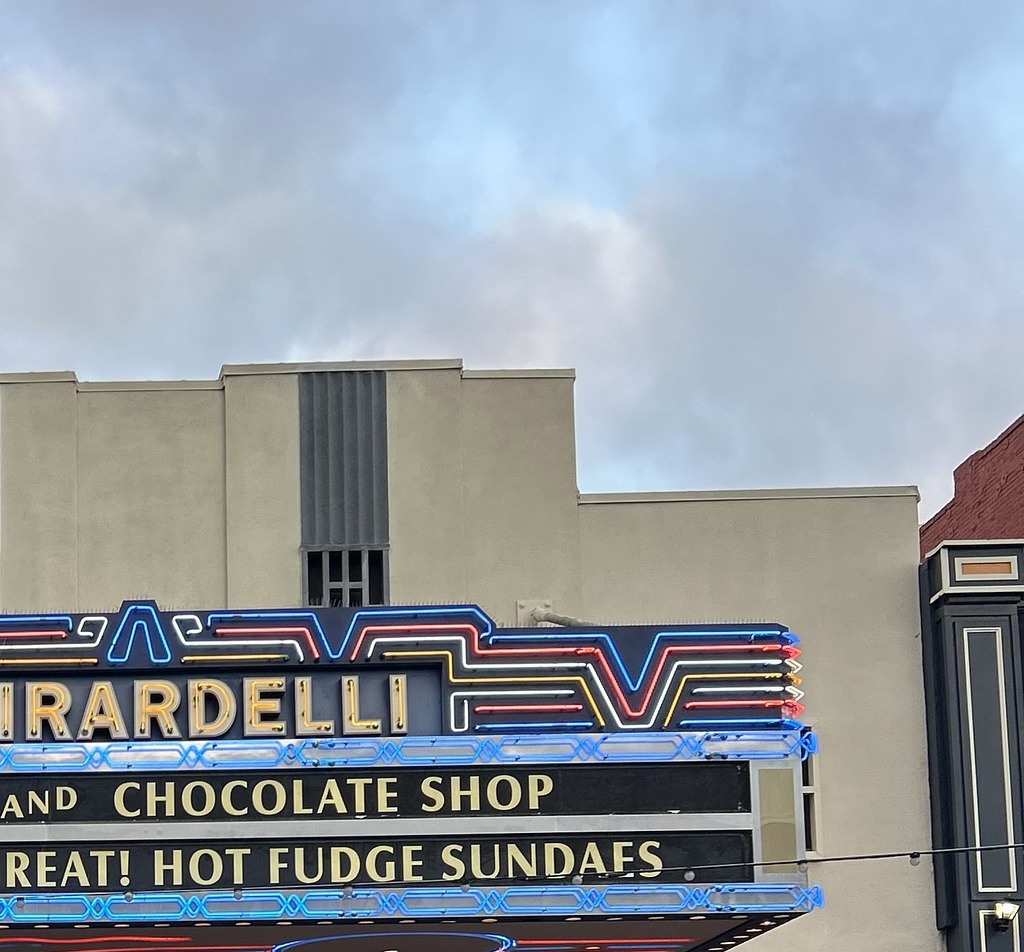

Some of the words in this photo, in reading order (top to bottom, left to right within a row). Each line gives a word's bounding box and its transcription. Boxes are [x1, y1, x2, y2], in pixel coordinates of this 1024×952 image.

[0, 787, 78, 820] AND
[113, 777, 399, 818] CHOCOLATE
[420, 774, 555, 812] SHOP
[154, 848, 251, 886] HOT
[269, 844, 423, 884] FUDGE
[441, 840, 664, 881] SUNDAES
